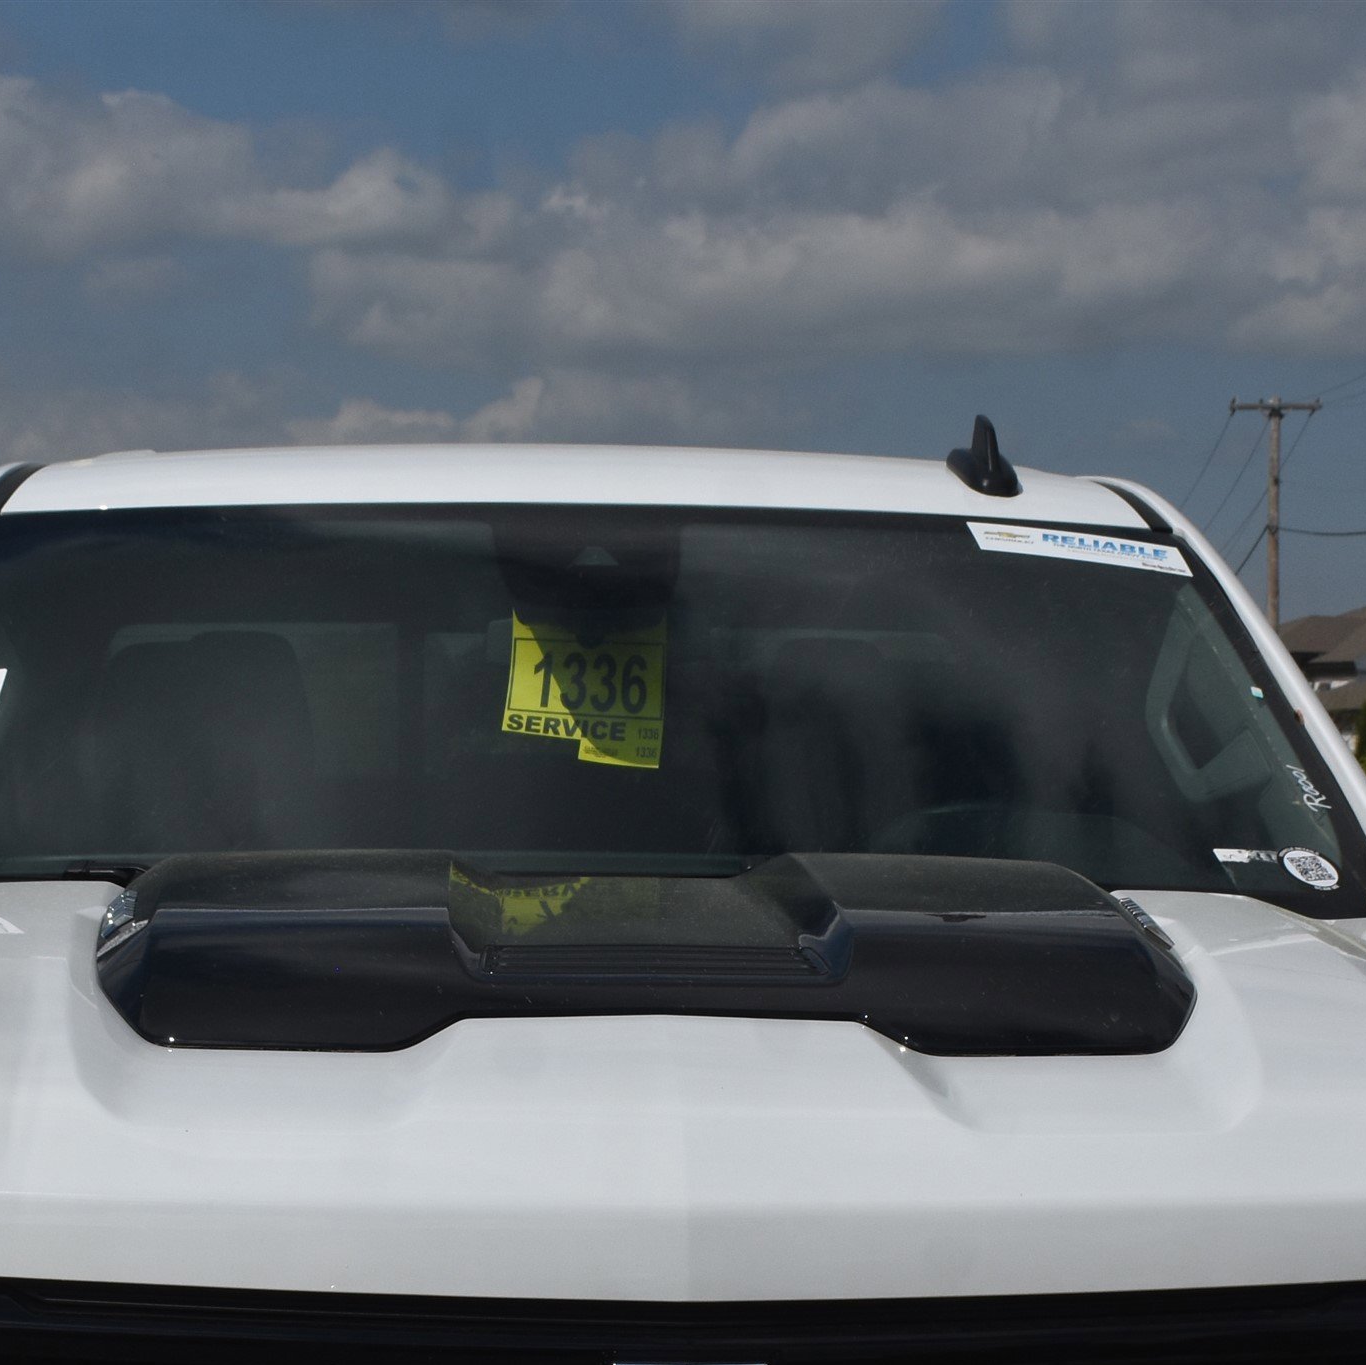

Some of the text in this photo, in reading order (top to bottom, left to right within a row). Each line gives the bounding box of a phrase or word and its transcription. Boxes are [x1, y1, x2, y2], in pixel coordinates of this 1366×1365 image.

[1042, 533, 1168, 559] RELIABLE
[534, 651, 647, 714] 1336
[506, 714, 626, 740] SERVICE
[638, 728, 660, 740] 1336
